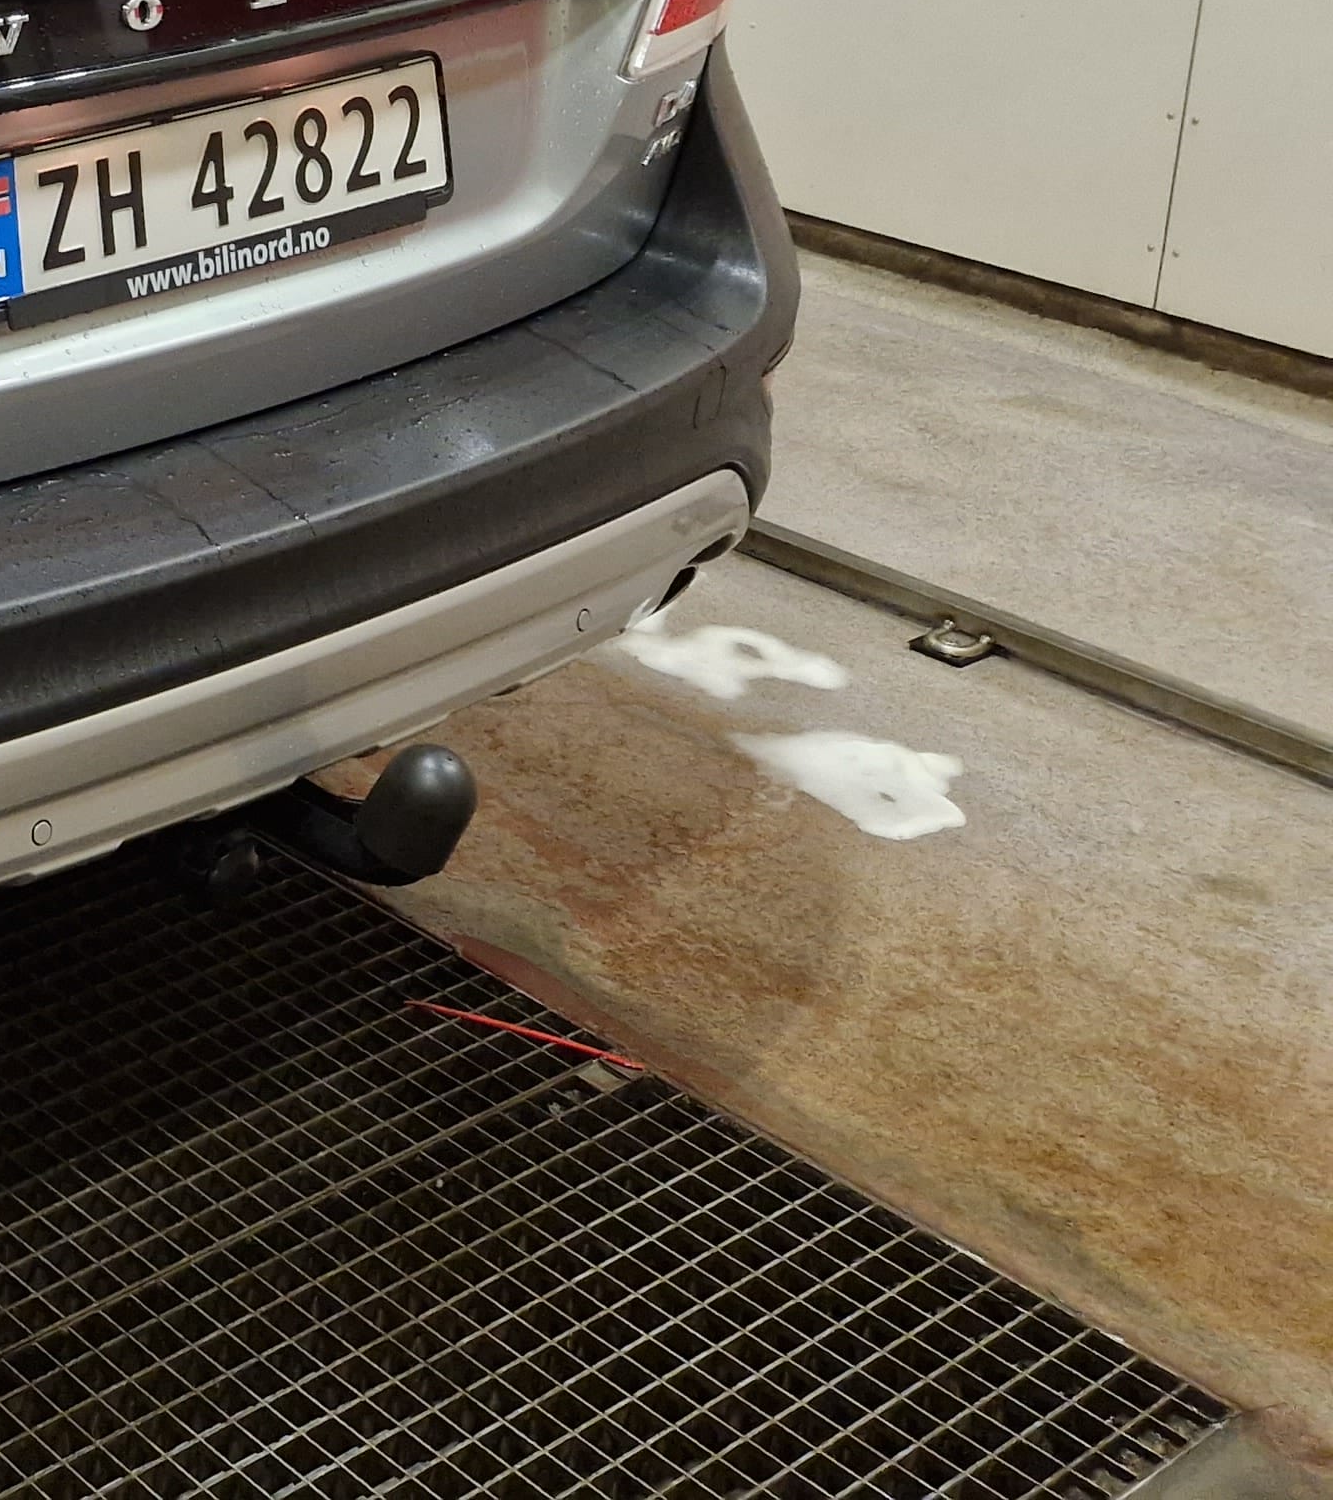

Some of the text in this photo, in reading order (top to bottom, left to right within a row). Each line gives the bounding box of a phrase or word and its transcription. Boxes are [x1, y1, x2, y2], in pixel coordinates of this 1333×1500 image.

[37, 84, 427, 271] ZH 42822
[127, 225, 331, 299] www.bilinord.no
